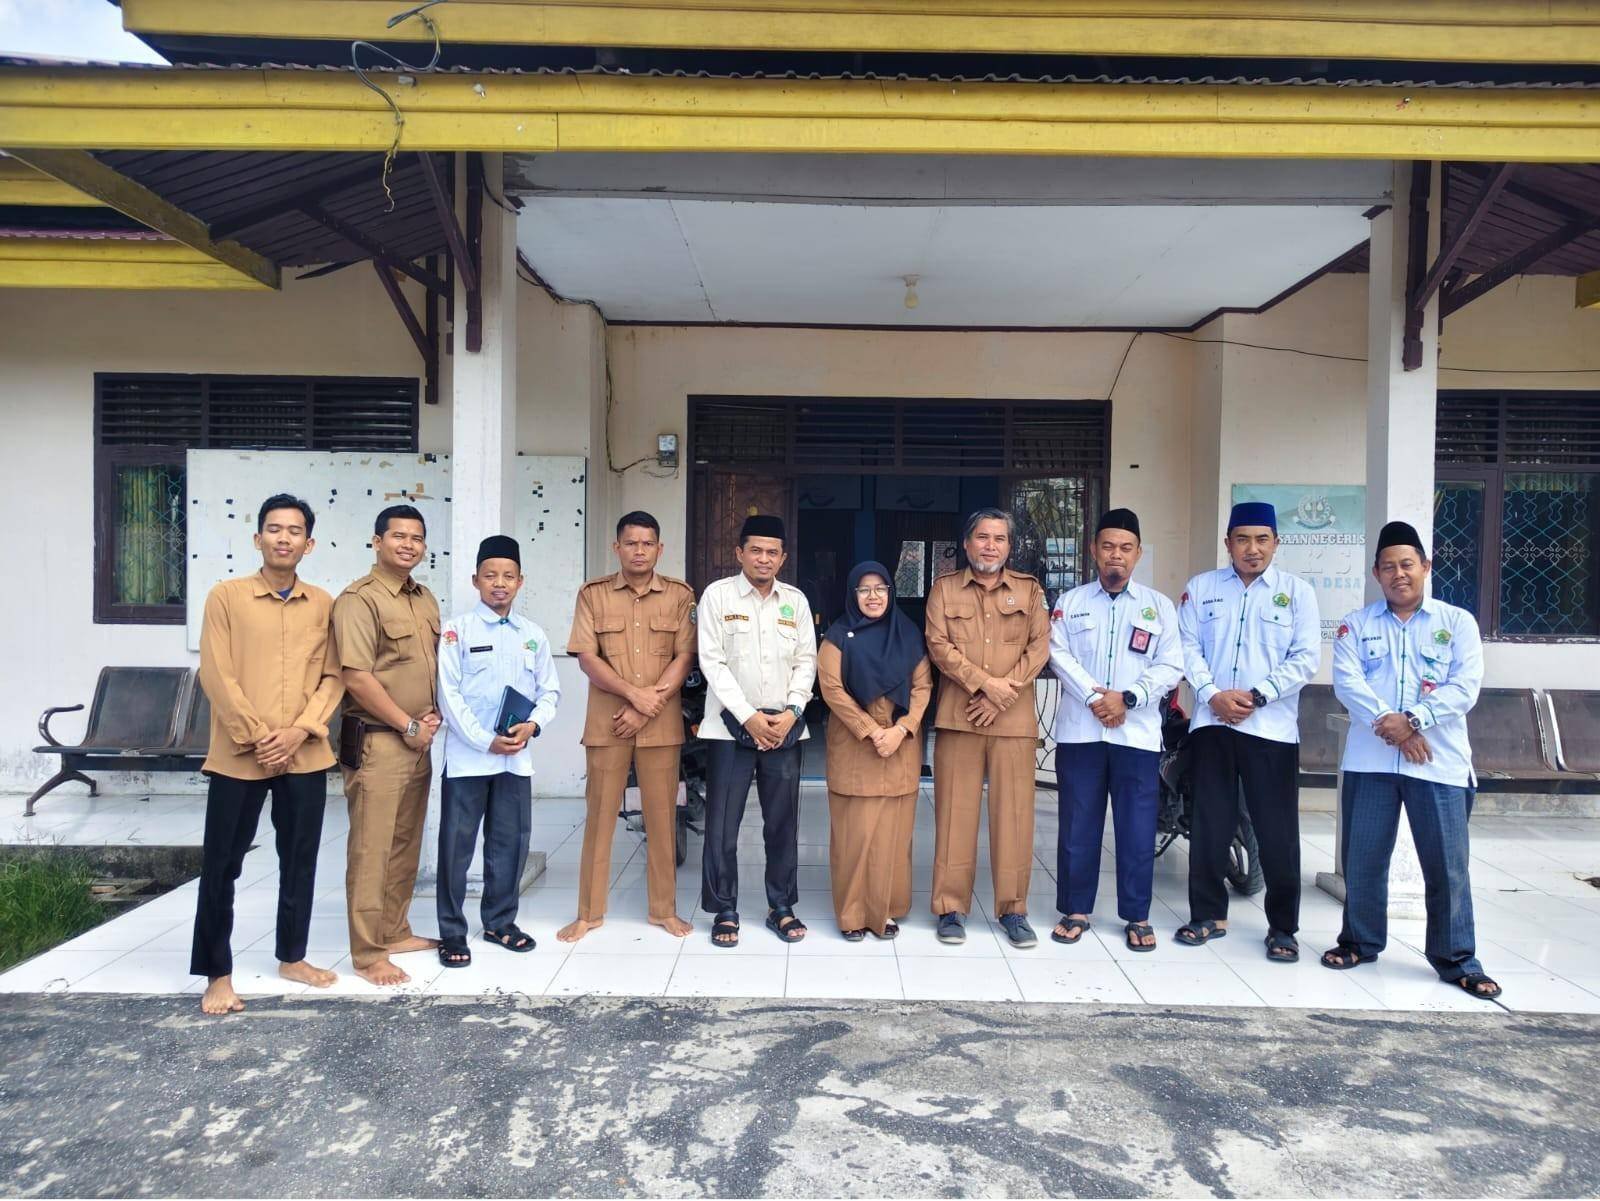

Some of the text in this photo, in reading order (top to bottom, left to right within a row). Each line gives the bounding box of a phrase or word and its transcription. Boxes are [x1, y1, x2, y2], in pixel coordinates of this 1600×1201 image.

[1279, 533, 1309, 545] SAAN
[1310, 533, 1357, 545] NEGERI
[1322, 576, 1362, 589] DESA
